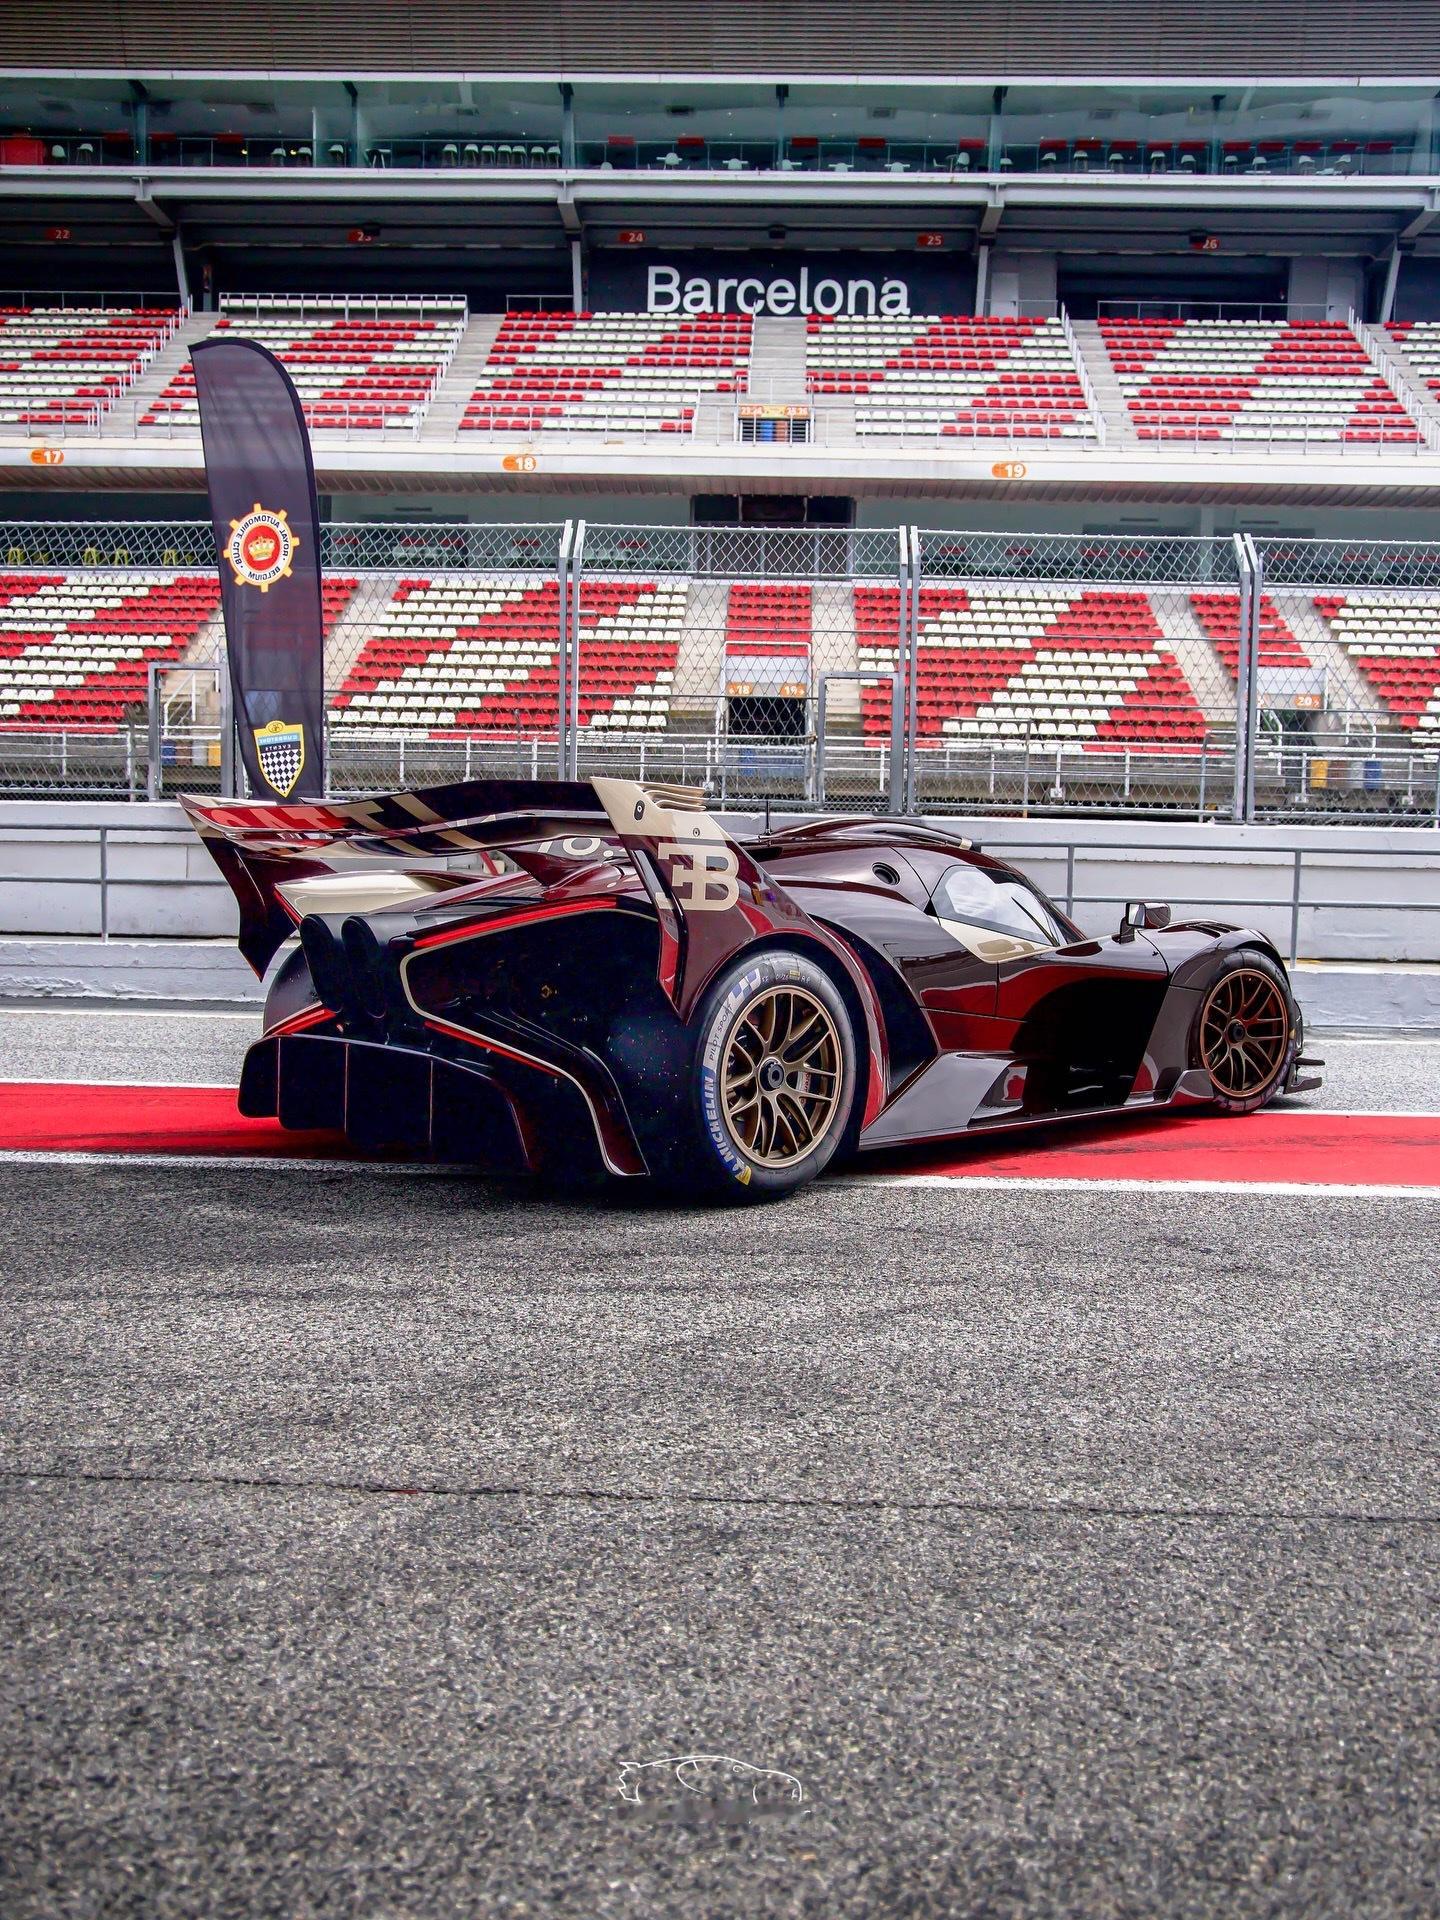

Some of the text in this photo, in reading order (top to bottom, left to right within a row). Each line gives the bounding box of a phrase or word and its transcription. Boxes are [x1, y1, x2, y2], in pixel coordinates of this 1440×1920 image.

[56, 229, 70, 239] 22
[629, 232, 643, 242] 24
[928, 235, 942, 246] 25
[1203, 239, 1217, 249] 26
[647, 265, 911, 315] Barcelona
[43, 450, 61, 464] 17
[515, 456, 534, 471] 18
[1005, 463, 1024, 478] 19
[709, 1003, 733, 1061] PILOT SPORT
[704, 1075, 735, 1163] MICHELIN
